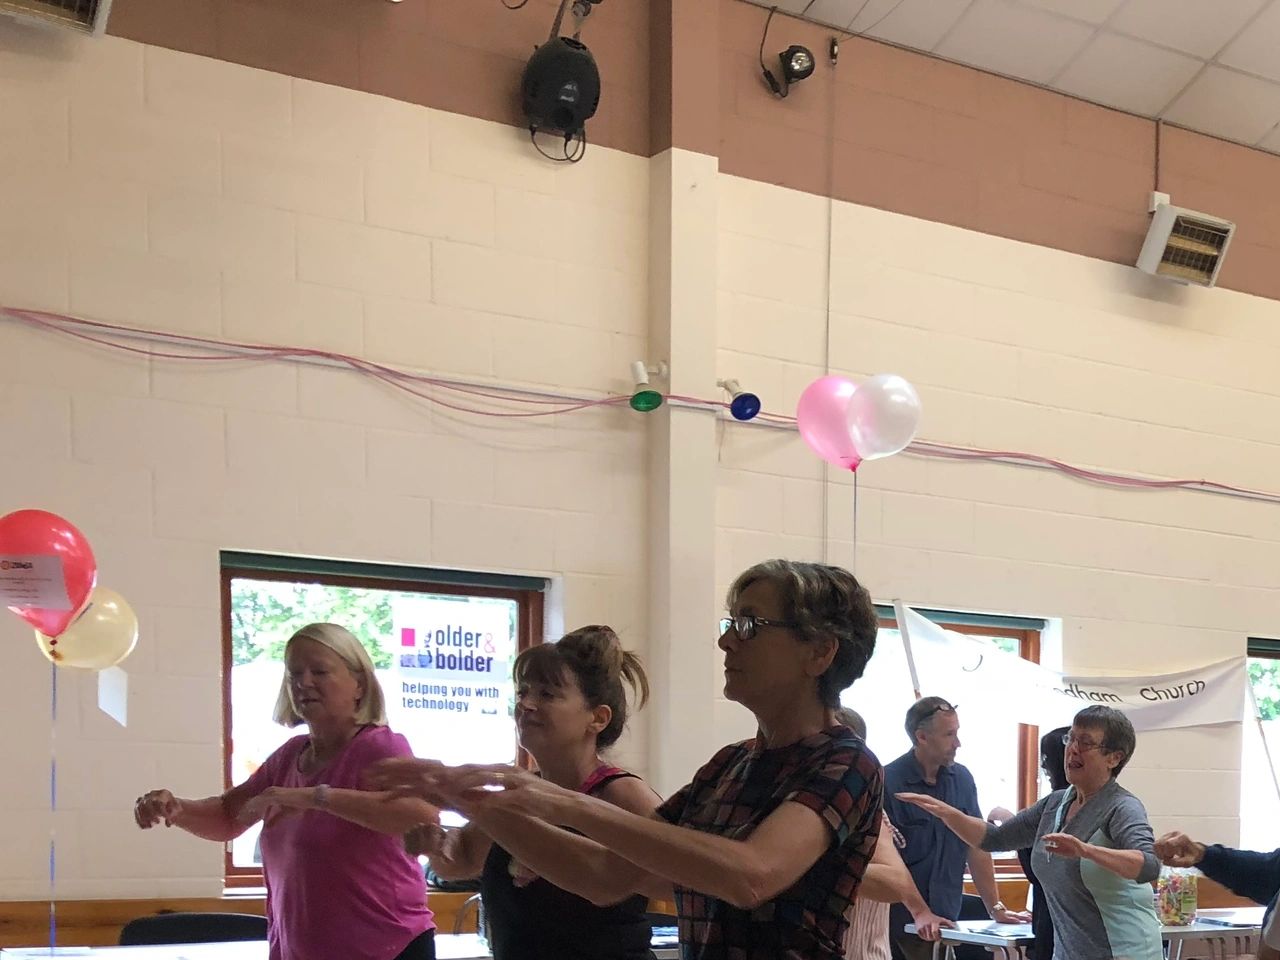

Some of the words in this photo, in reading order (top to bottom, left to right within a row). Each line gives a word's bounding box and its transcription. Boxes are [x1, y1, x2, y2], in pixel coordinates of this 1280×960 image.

[435, 624, 482, 648] older
[483, 632, 496, 654] &
[435, 647, 494, 673] bolder
[402, 681, 448, 697] helping
[451, 686, 472, 697] you
[475, 686, 500, 699] with
[1139, 680, 1206, 701] Church
[402, 696, 469, 712] technology
